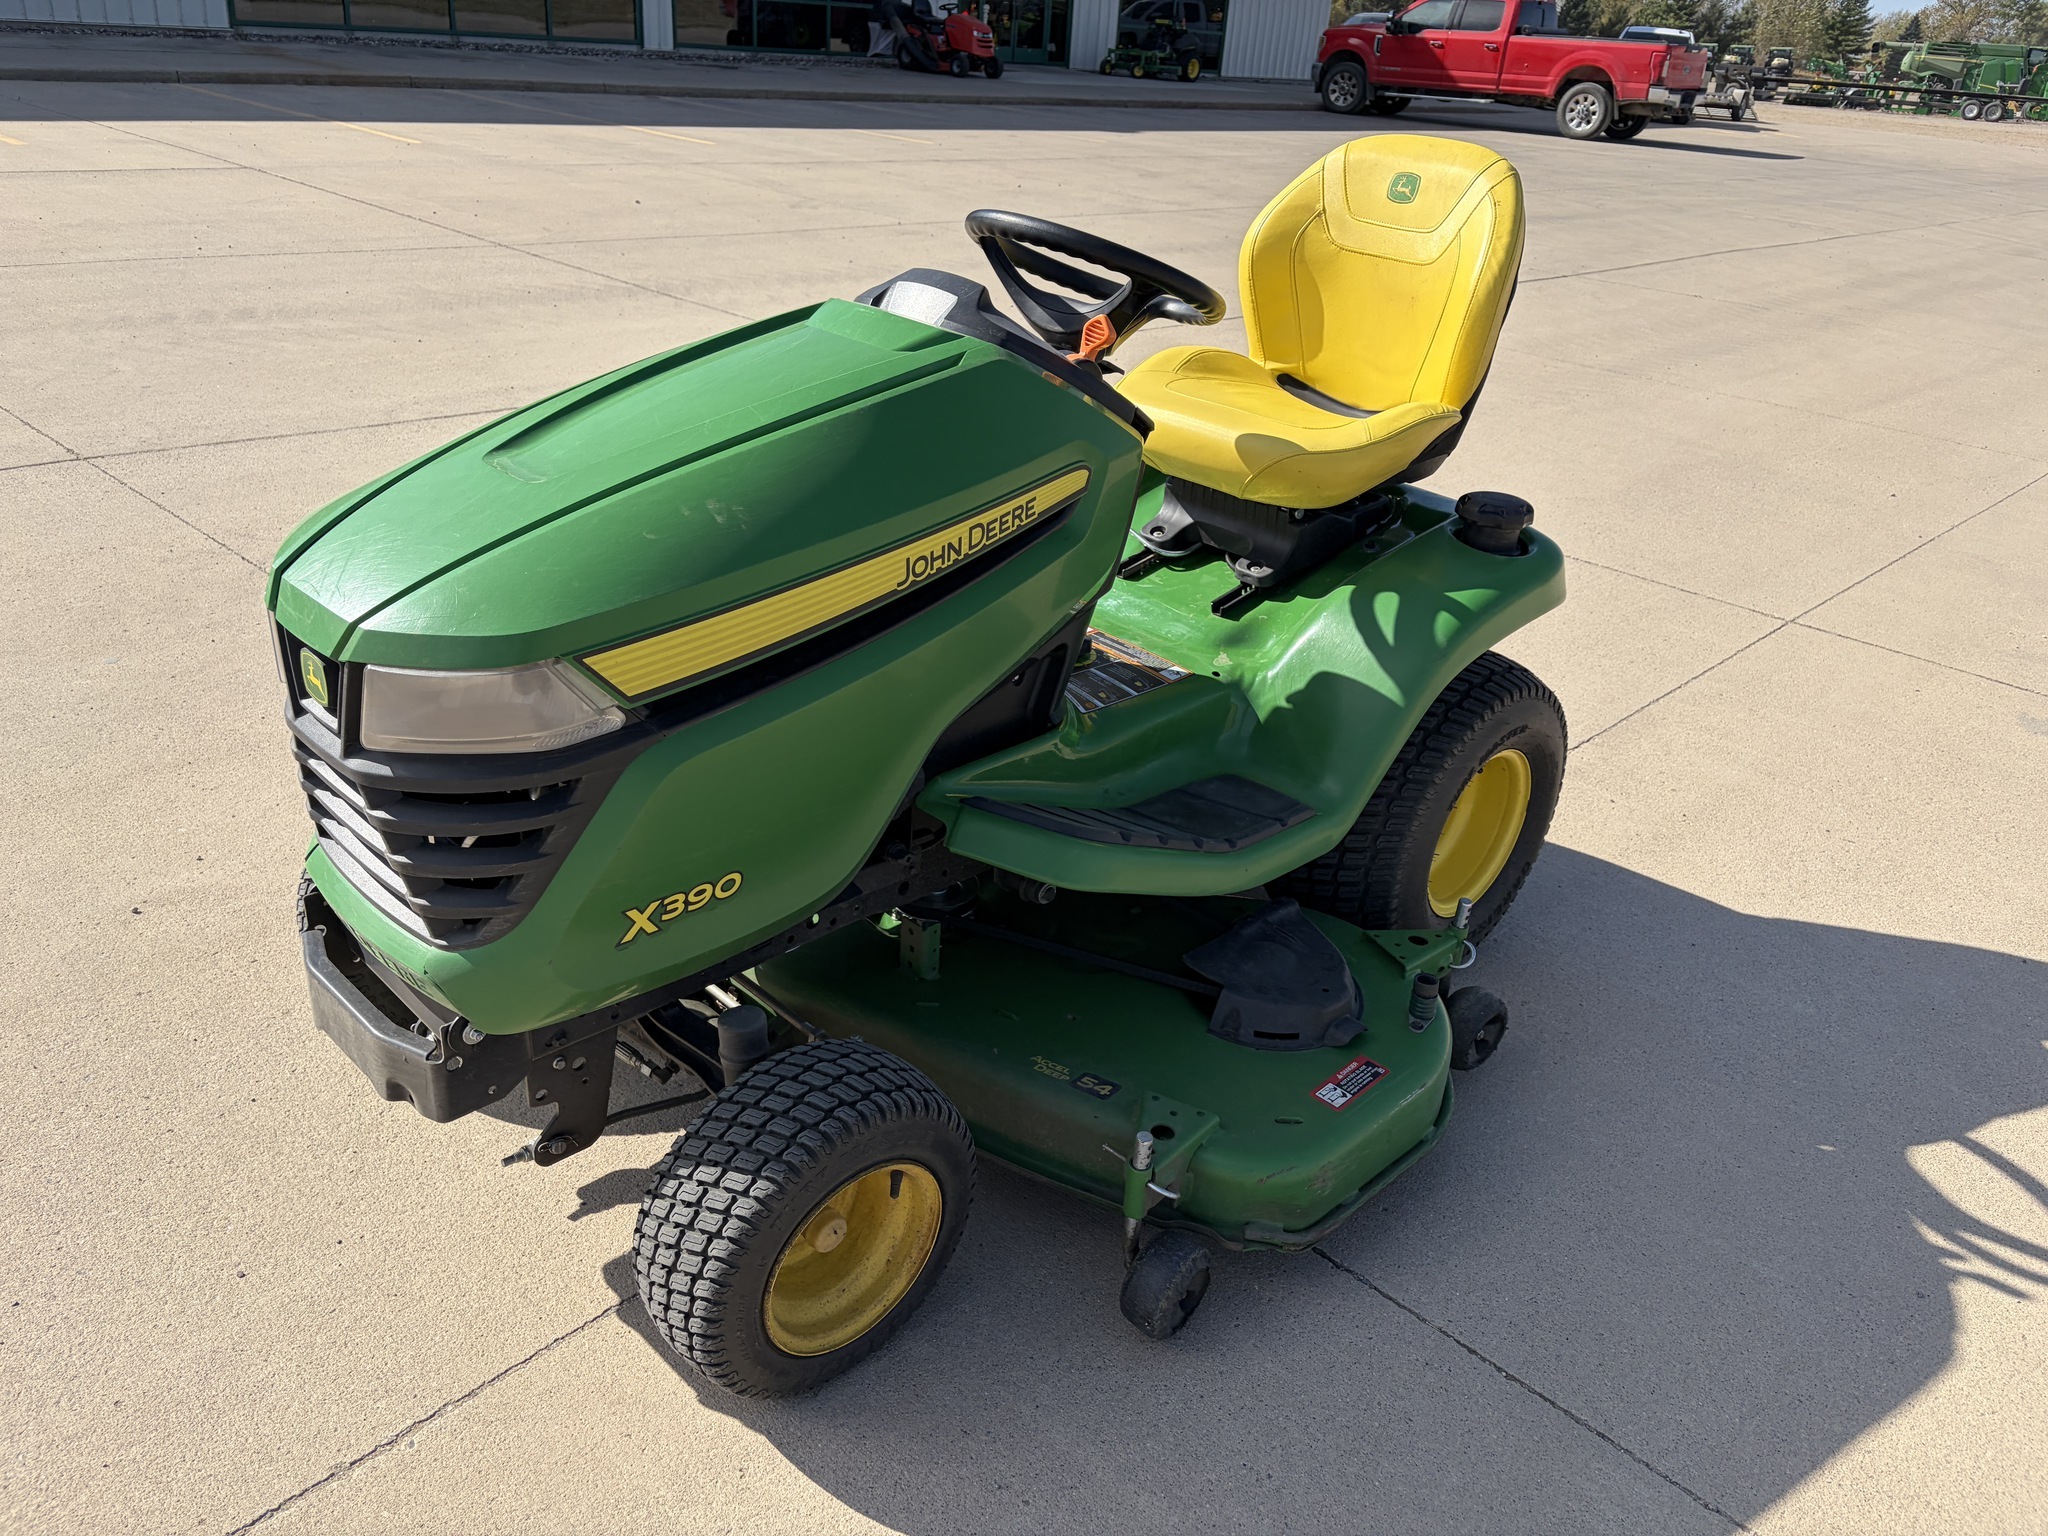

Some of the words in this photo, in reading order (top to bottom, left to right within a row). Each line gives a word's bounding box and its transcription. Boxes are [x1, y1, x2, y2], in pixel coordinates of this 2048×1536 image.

[896, 536, 963, 590] JOHN
[968, 496, 1037, 553] DEERE
[616, 871, 743, 946] X390
[1030, 1055, 1070, 1075] ACCEL
[1033, 1063, 1070, 1080] DEEP
[1340, 1061, 1358, 1076] DANGER
[1076, 1076, 1114, 1096] 54
